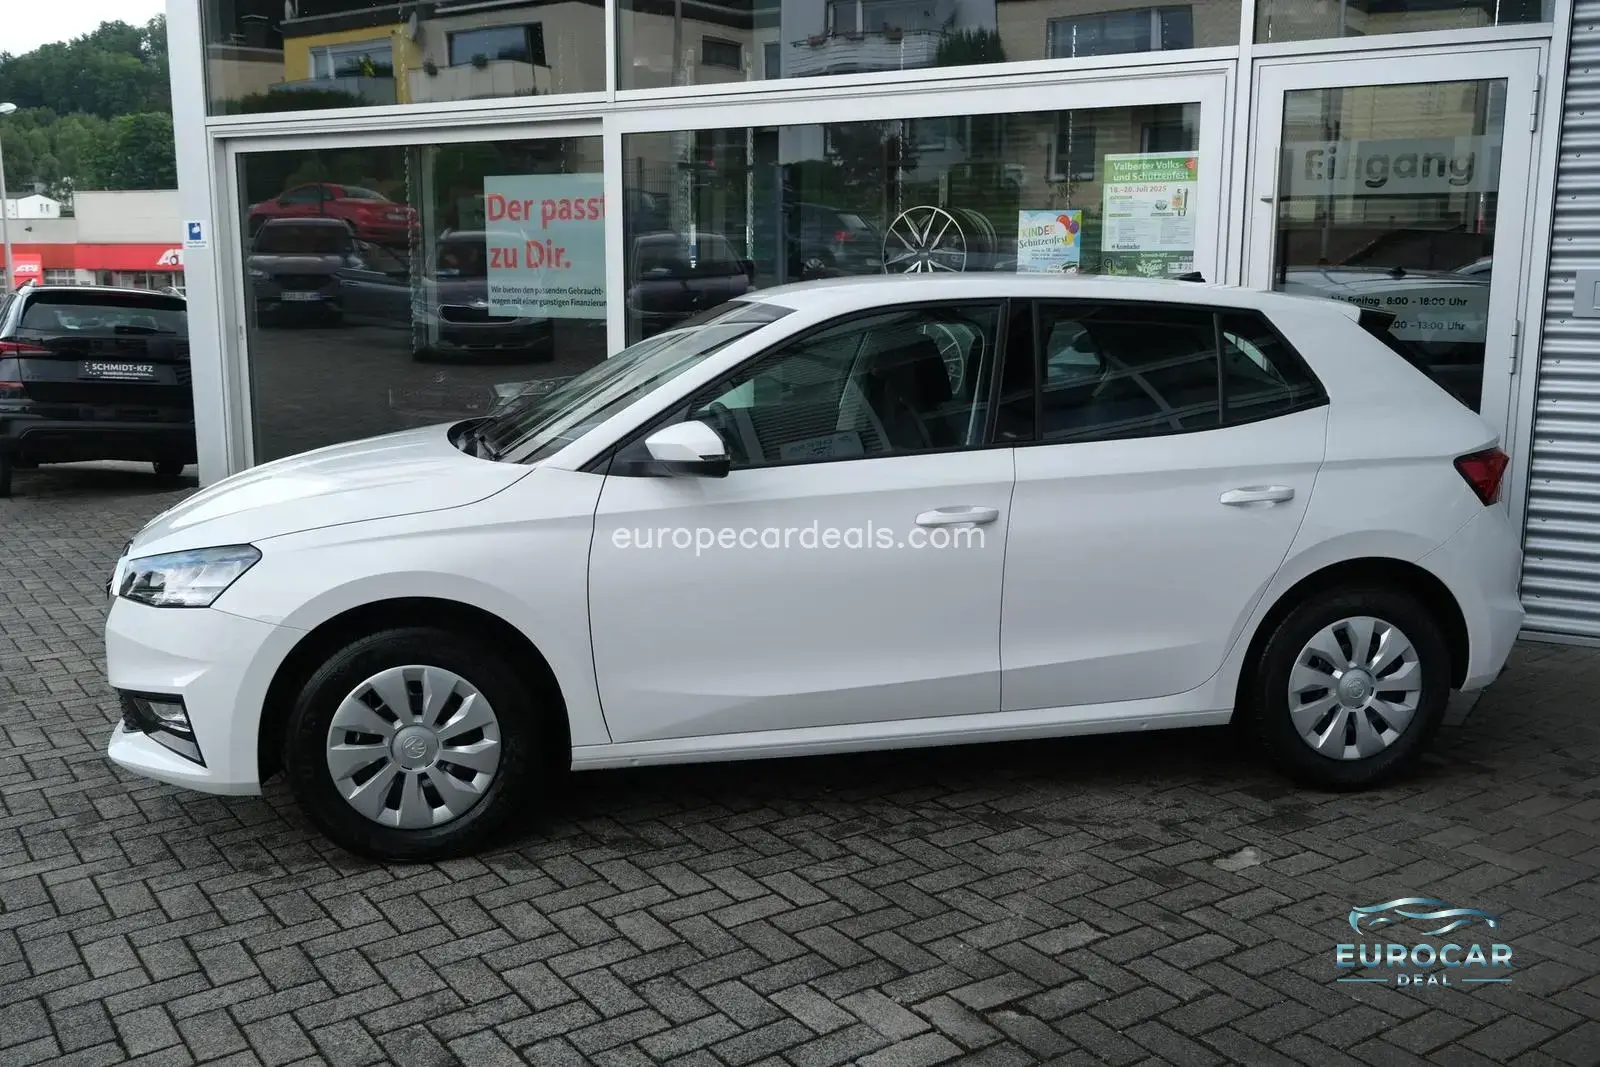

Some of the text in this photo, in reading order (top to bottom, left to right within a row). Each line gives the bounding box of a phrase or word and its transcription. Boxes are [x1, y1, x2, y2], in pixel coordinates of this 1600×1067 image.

[1156, 160, 1183, 169] Volks-
[1305, 146, 1475, 188] Eingang
[1113, 172, 1130, 181] und
[487, 191, 605, 229] Der passt
[490, 239, 572, 269] zu Dir.
[522, 286, 534, 294] den
[491, 299, 510, 307] wagen
[1386, 297, 1409, 305] 8:00
[1419, 297, 1446, 306] 18:00
[1449, 297, 1468, 306] Uhr
[1390, 321, 1408, 329] :00
[1418, 321, 1444, 330] 13:00
[1448, 321, 1466, 331] Uhr
[91, 363, 154, 372] SCHMIDT-KFZ
